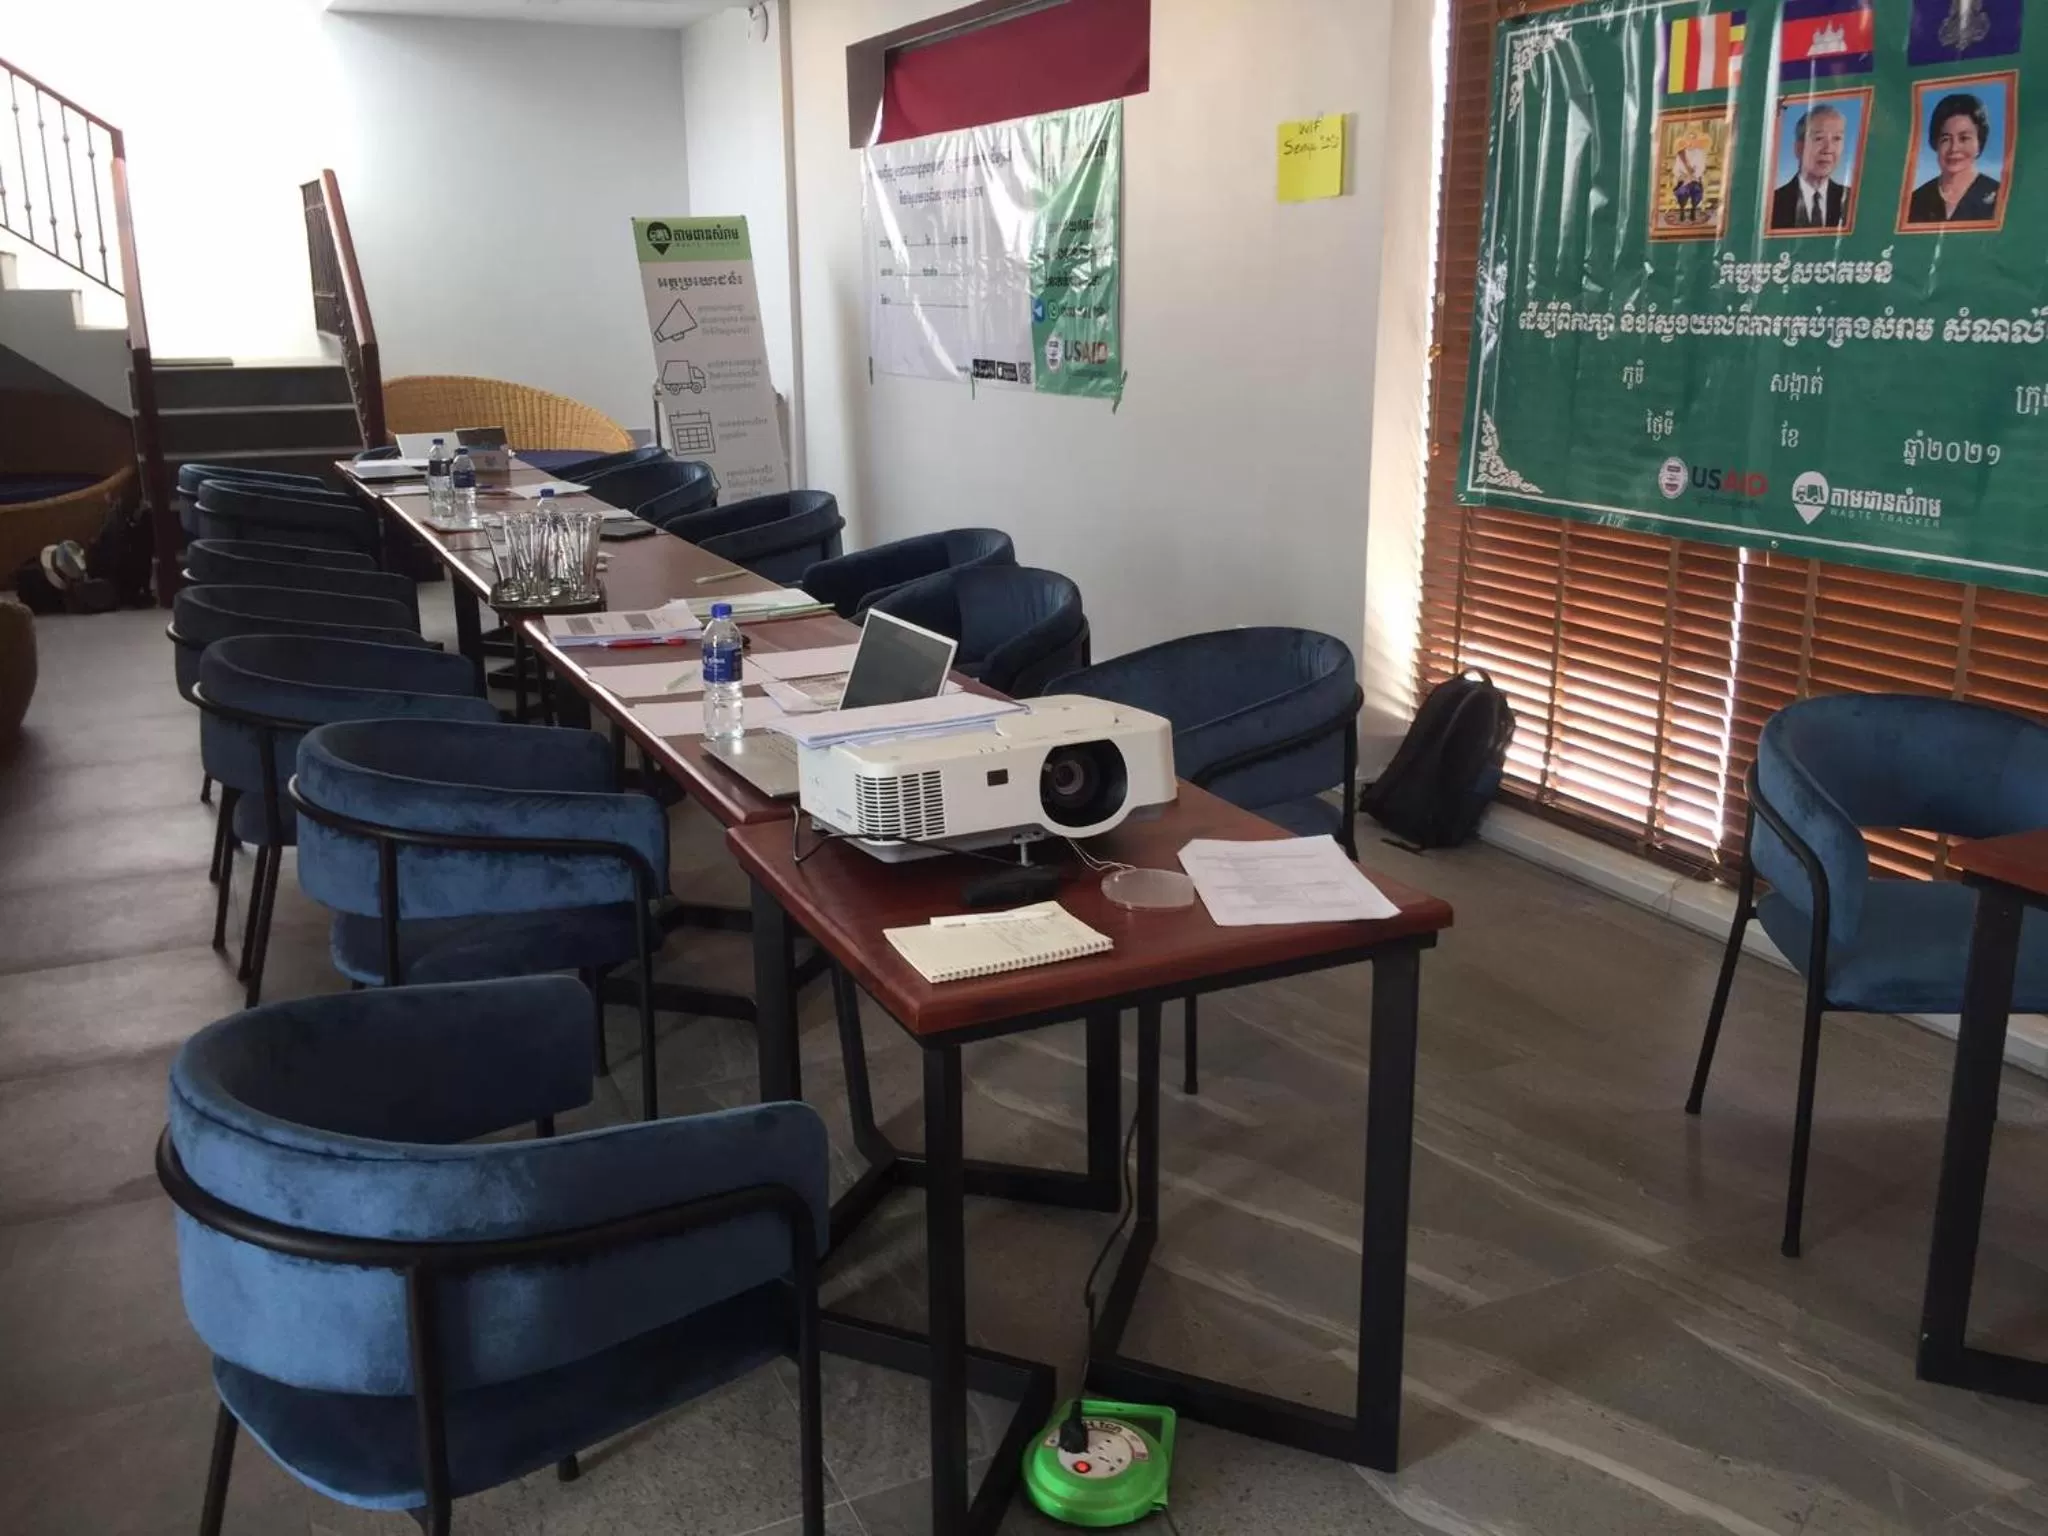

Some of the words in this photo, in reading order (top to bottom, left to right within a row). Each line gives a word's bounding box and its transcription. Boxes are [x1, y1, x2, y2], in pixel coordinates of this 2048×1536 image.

[1064, 339, 1108, 365] USAID
[1770, 366, 1824, 401] សង្កាត់
[1780, 420, 1800, 448] ខែ
[1692, 465, 1769, 497] USAID
[1830, 487, 1942, 518] តាមដានសំរាម
[1830, 507, 1871, 520] WASTE
[1880, 512, 1940, 528] TRACKER
